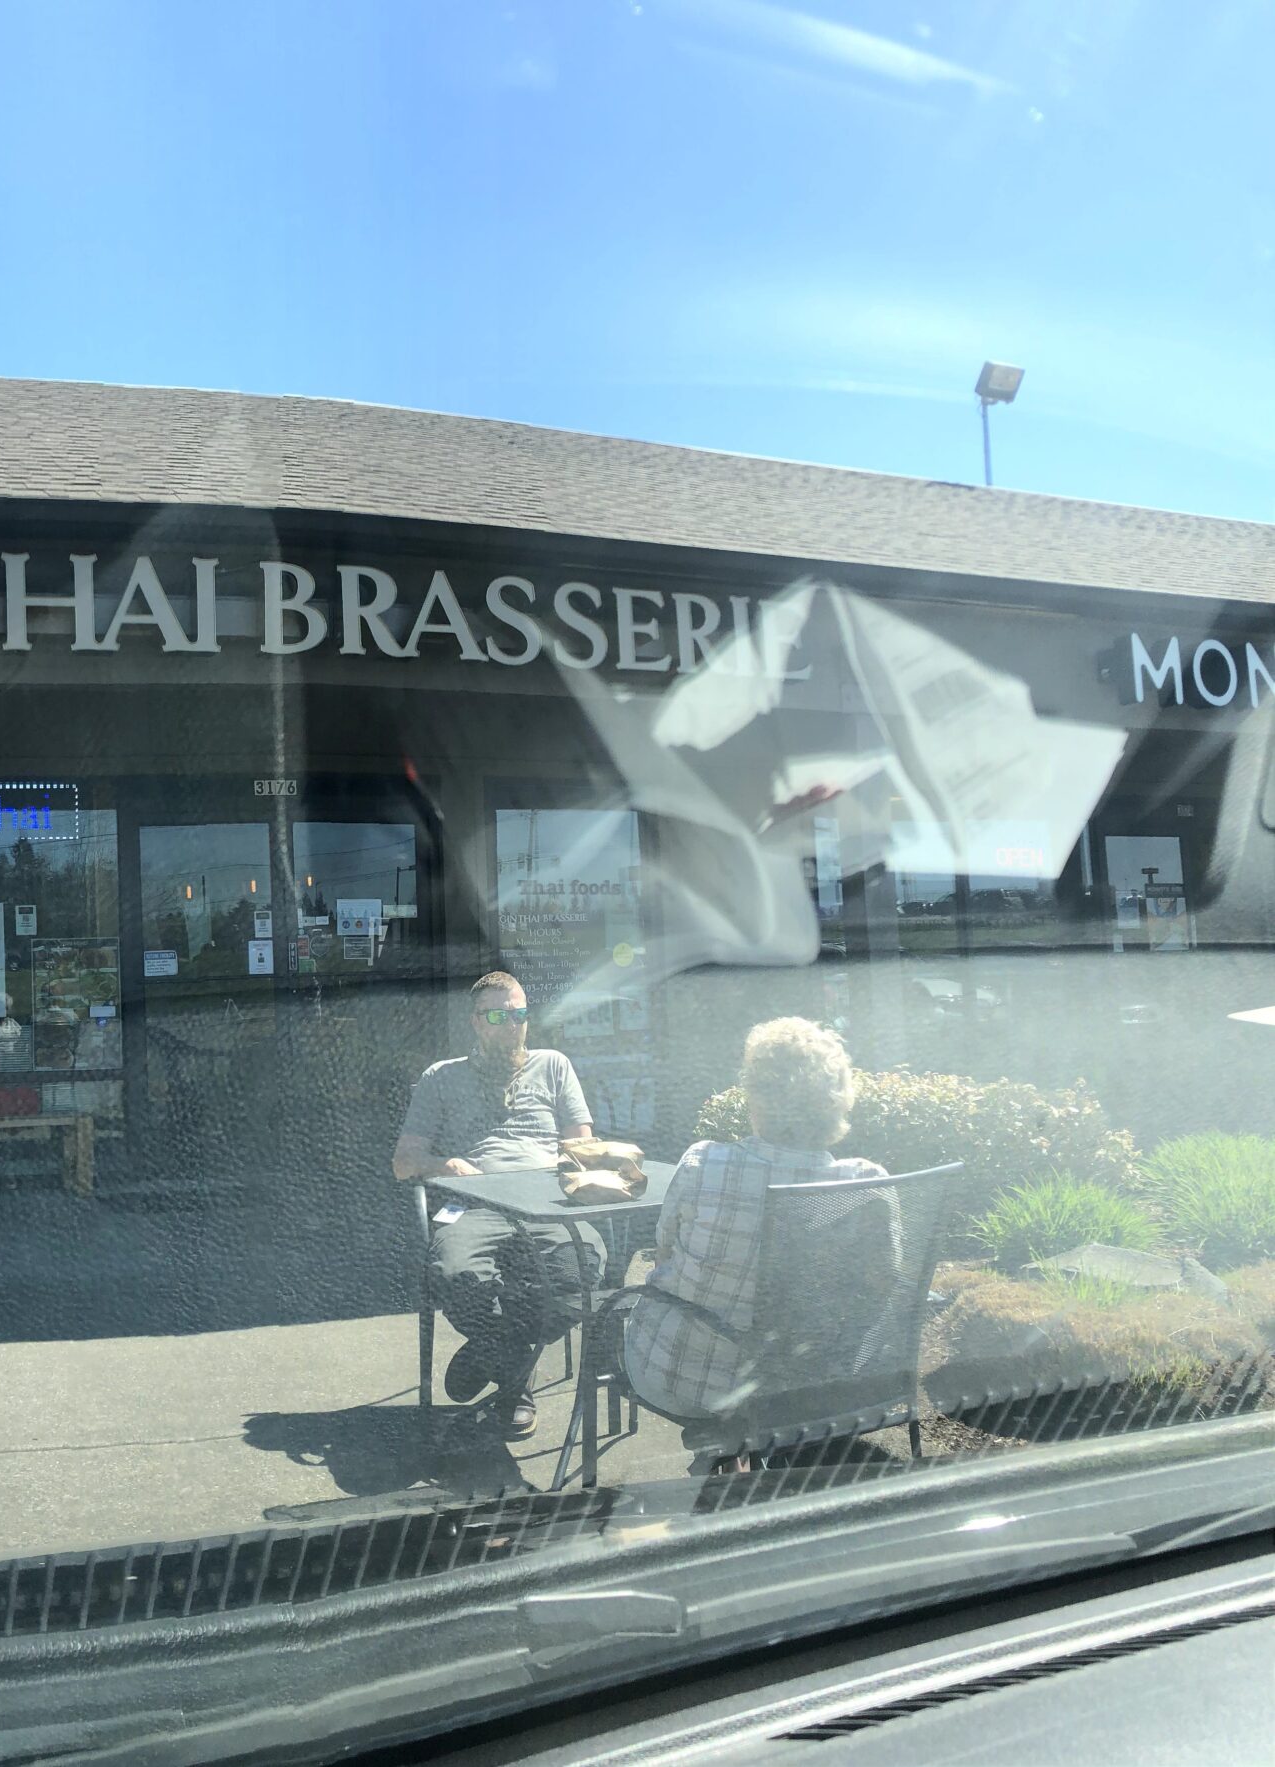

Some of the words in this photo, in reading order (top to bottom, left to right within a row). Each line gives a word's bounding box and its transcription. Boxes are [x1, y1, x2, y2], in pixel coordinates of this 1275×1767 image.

[259, 561, 811, 681] BRASSERIE
[255, 780, 296, 795] 3176
[996, 847, 1044, 867] OPEN
[517, 879, 565, 895] Thai
[570, 879, 622, 895] foods
[529, 928, 562, 937] HOURS
